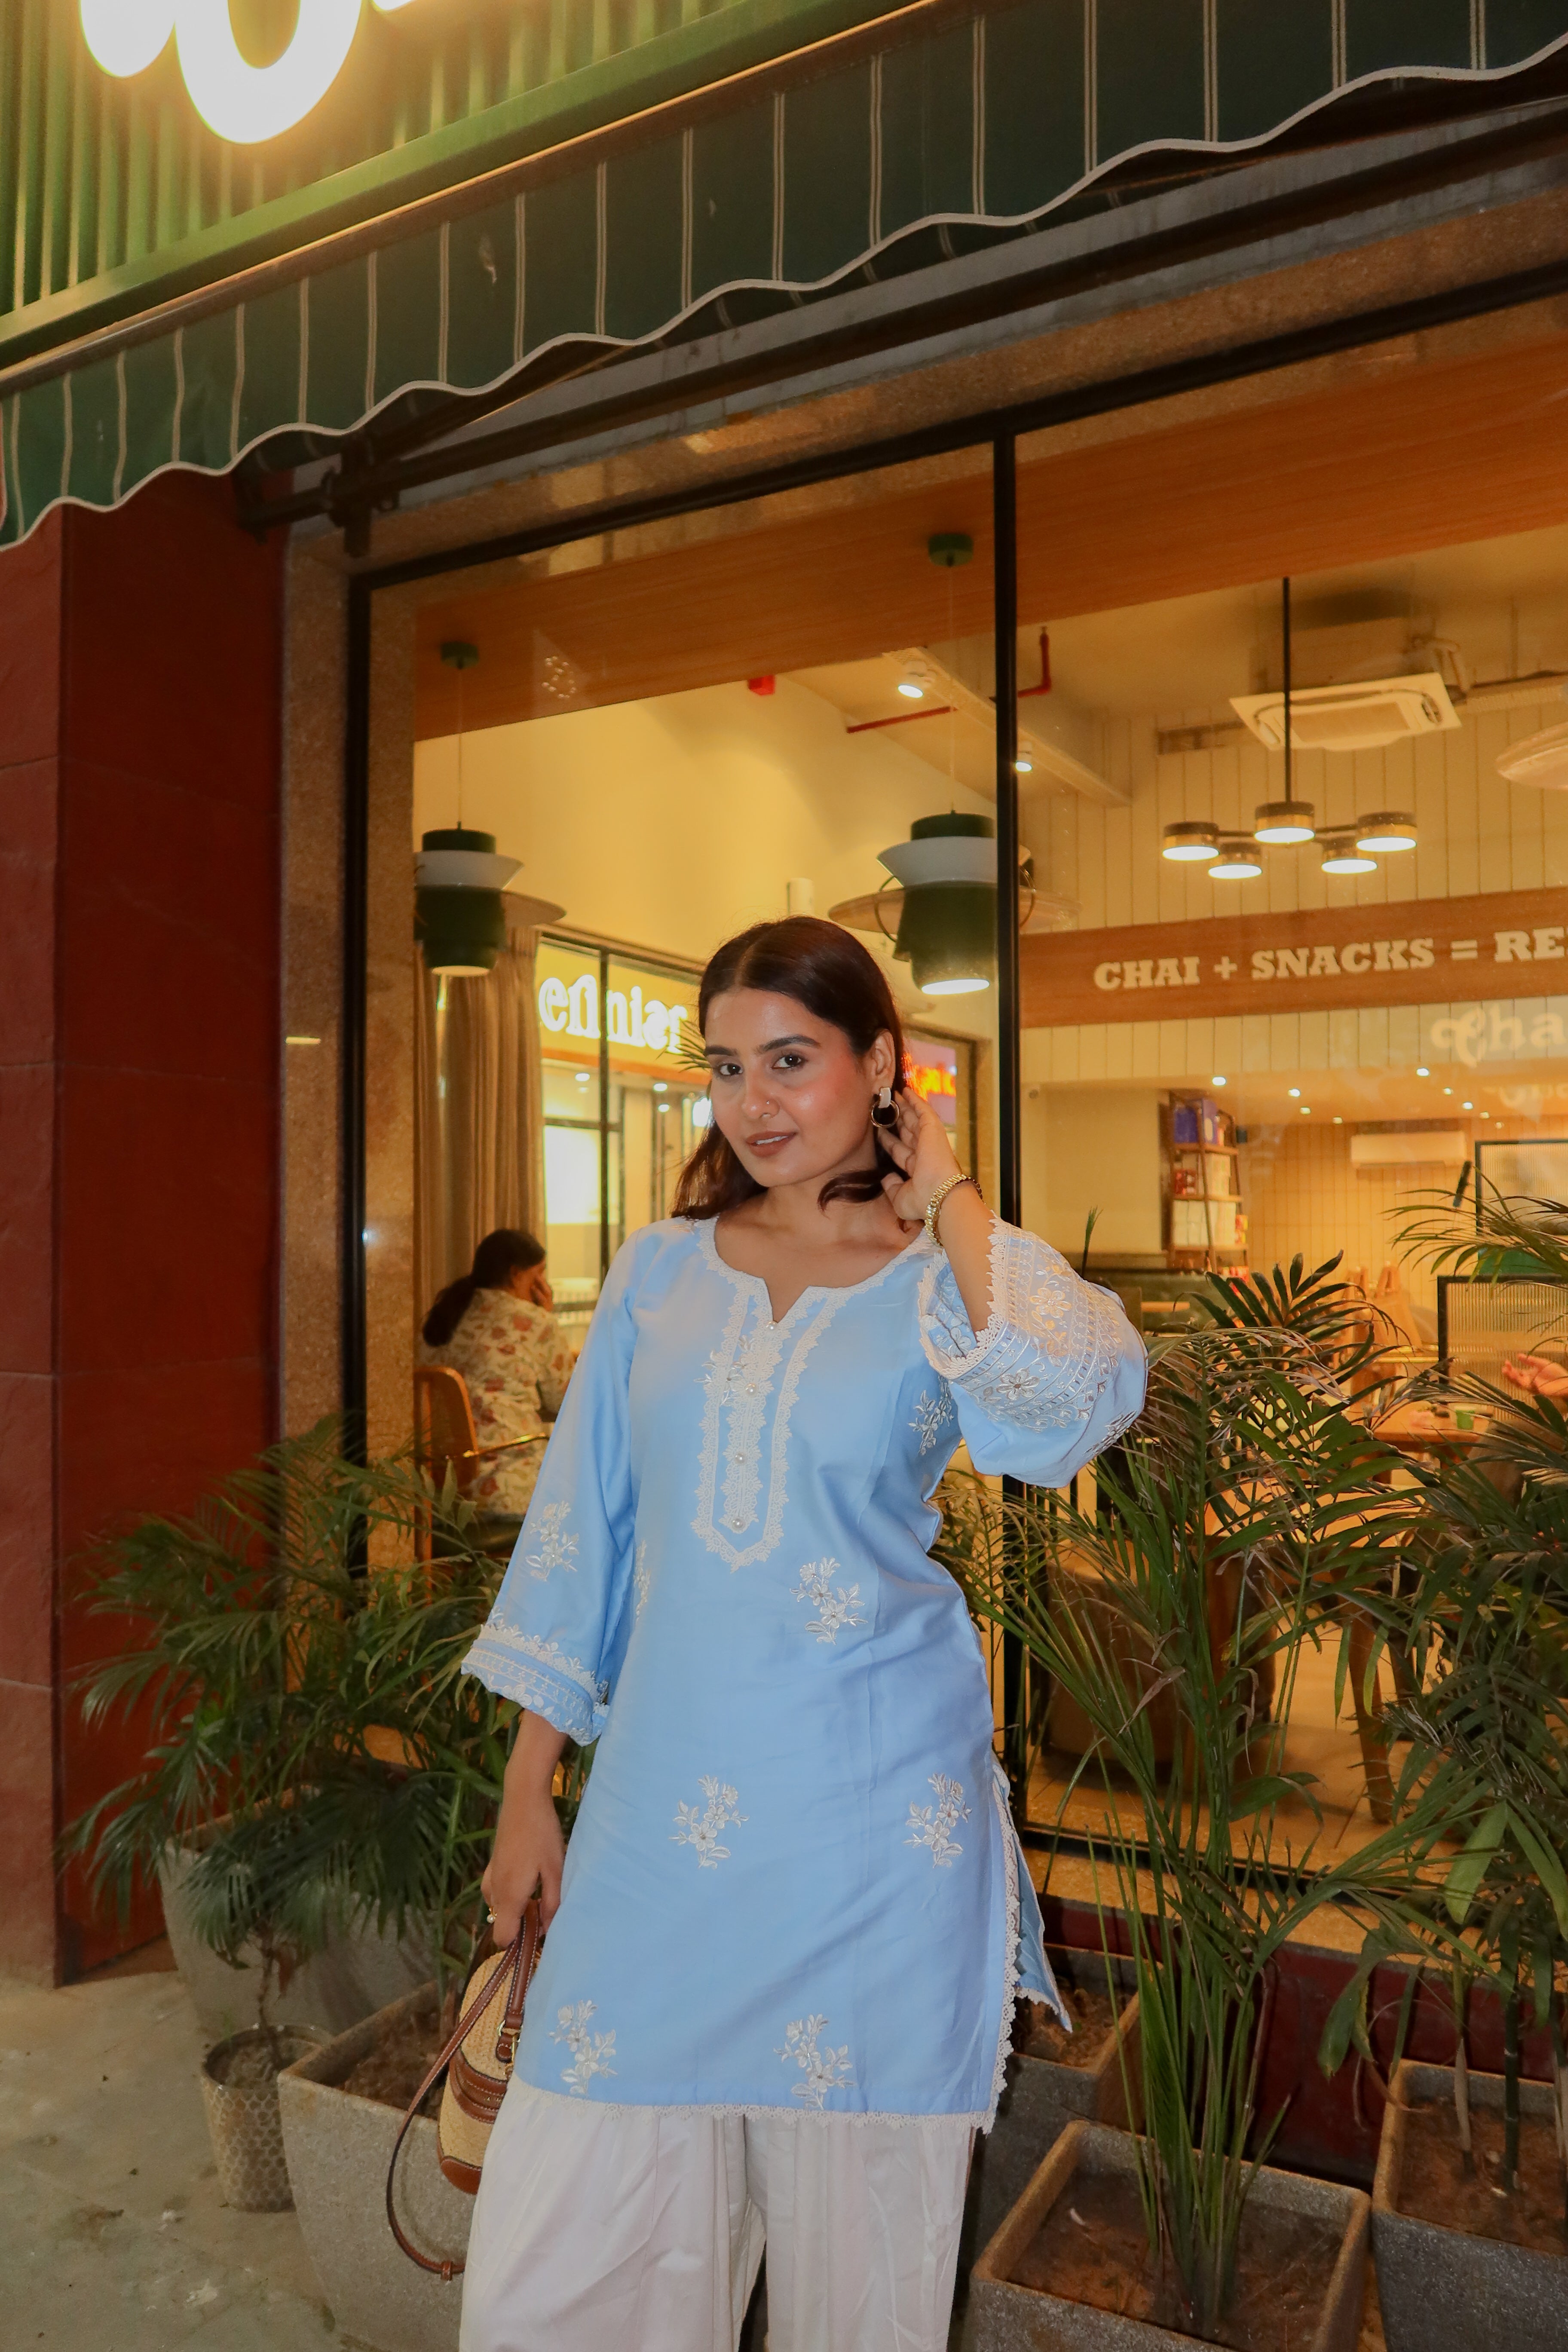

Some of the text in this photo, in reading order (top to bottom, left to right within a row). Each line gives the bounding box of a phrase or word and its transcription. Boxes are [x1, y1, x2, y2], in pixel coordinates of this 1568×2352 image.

[1093, 926, 1568, 990] CHAI + SNACKS = RE
